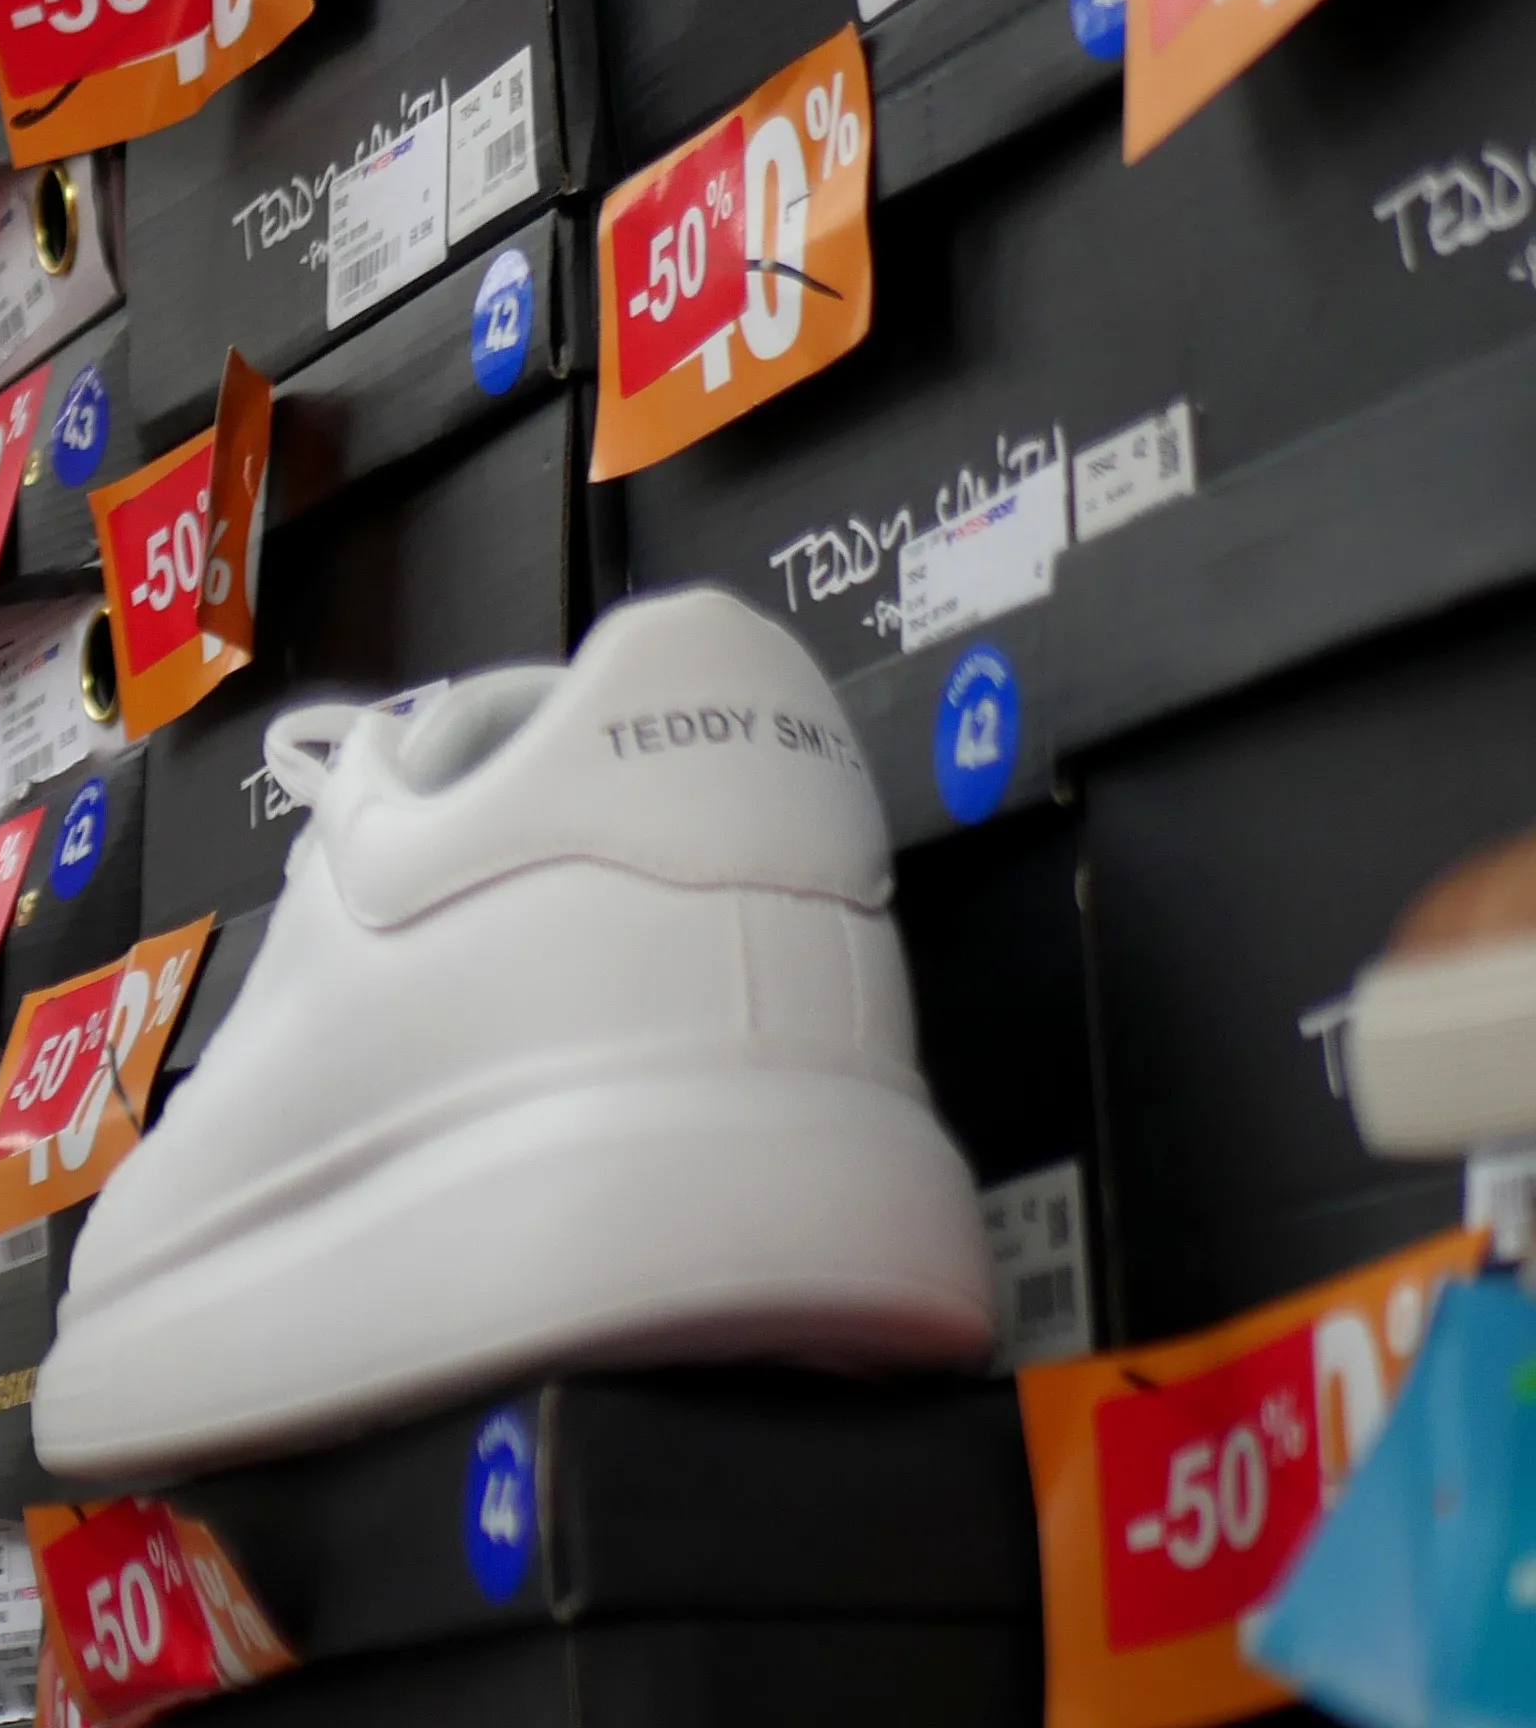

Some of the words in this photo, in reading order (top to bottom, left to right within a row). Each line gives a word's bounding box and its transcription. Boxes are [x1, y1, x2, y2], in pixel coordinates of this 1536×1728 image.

[629, 170, 734, 324] -50%
[485, 297, 520, 352] 42
[63, 405, 95, 452] 43
[602, 707, 757, 760] TEDDY
[954, 697, 1000, 770] 42
[59, 815, 95, 867] 42
[9, 1008, 107, 1111] -50%
[1126, 1392, 1306, 1569] -50%
[82, 1531, 184, 1682] -50%
